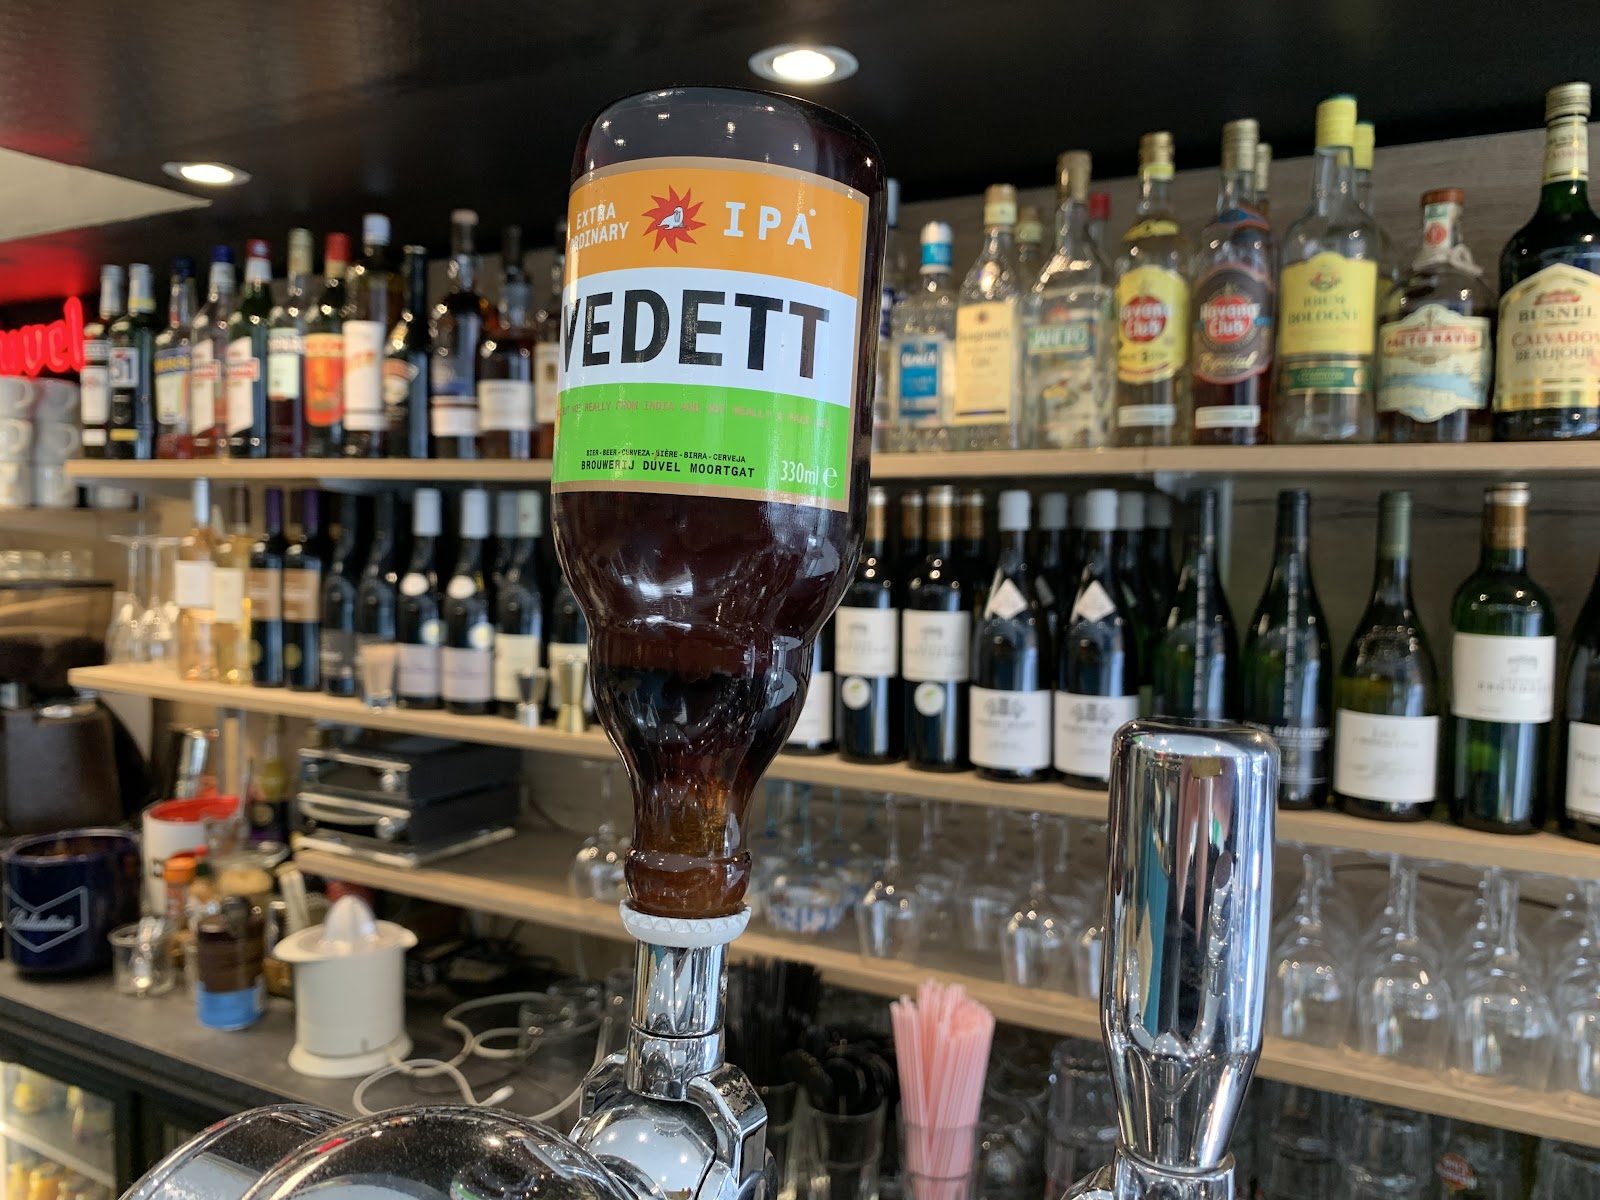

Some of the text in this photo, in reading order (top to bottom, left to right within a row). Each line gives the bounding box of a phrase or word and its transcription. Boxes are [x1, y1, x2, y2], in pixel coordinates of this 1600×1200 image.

[576, 202, 616, 230] EXTRA
[563, 288, 829, 380] VEDETT
[581, 459, 755, 478] BROUWERIJ DUVEL MOORTGAT
